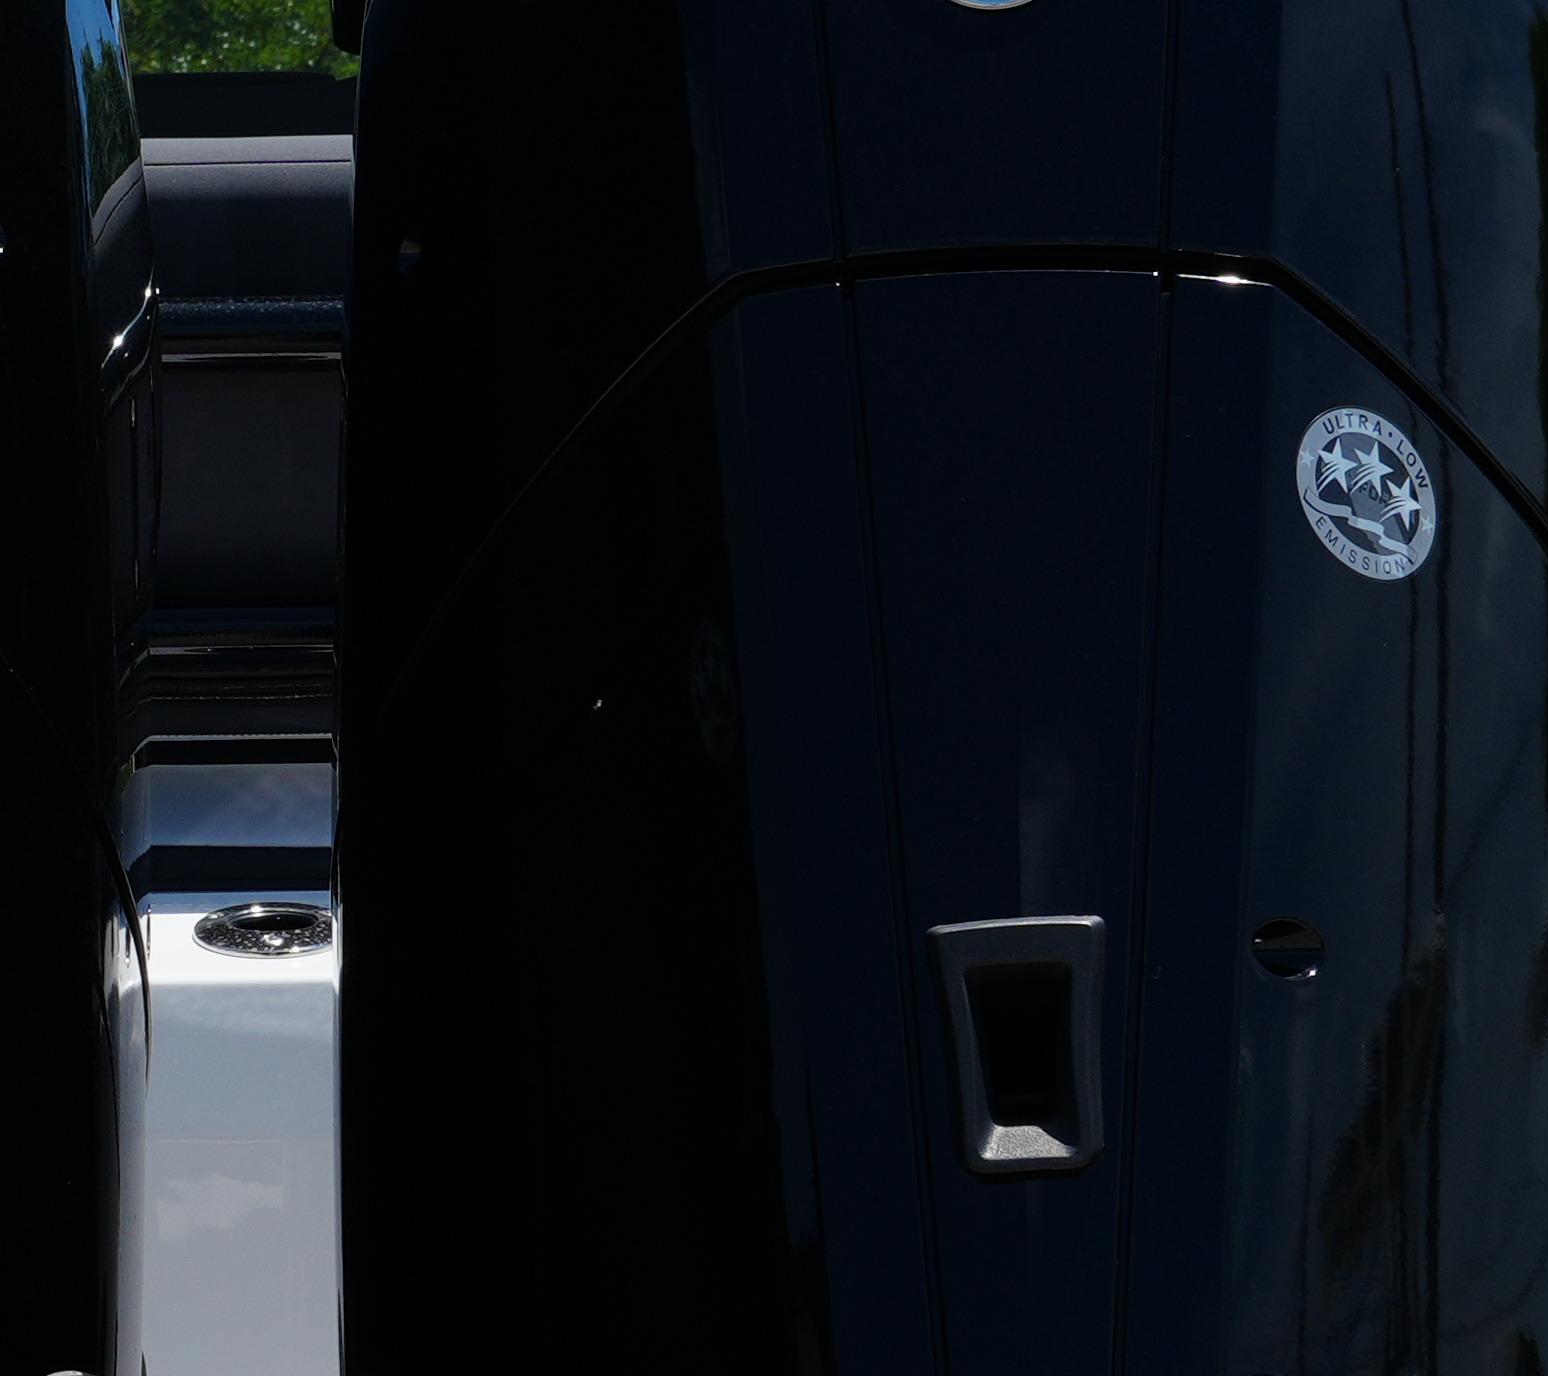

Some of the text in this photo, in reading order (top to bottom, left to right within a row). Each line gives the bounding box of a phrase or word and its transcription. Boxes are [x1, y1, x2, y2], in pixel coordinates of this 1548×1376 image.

[1323, 413, 1383, 435] ULTRA
[1397, 439, 1429, 490] LOW
[1315, 516, 1407, 575] EMISSION
